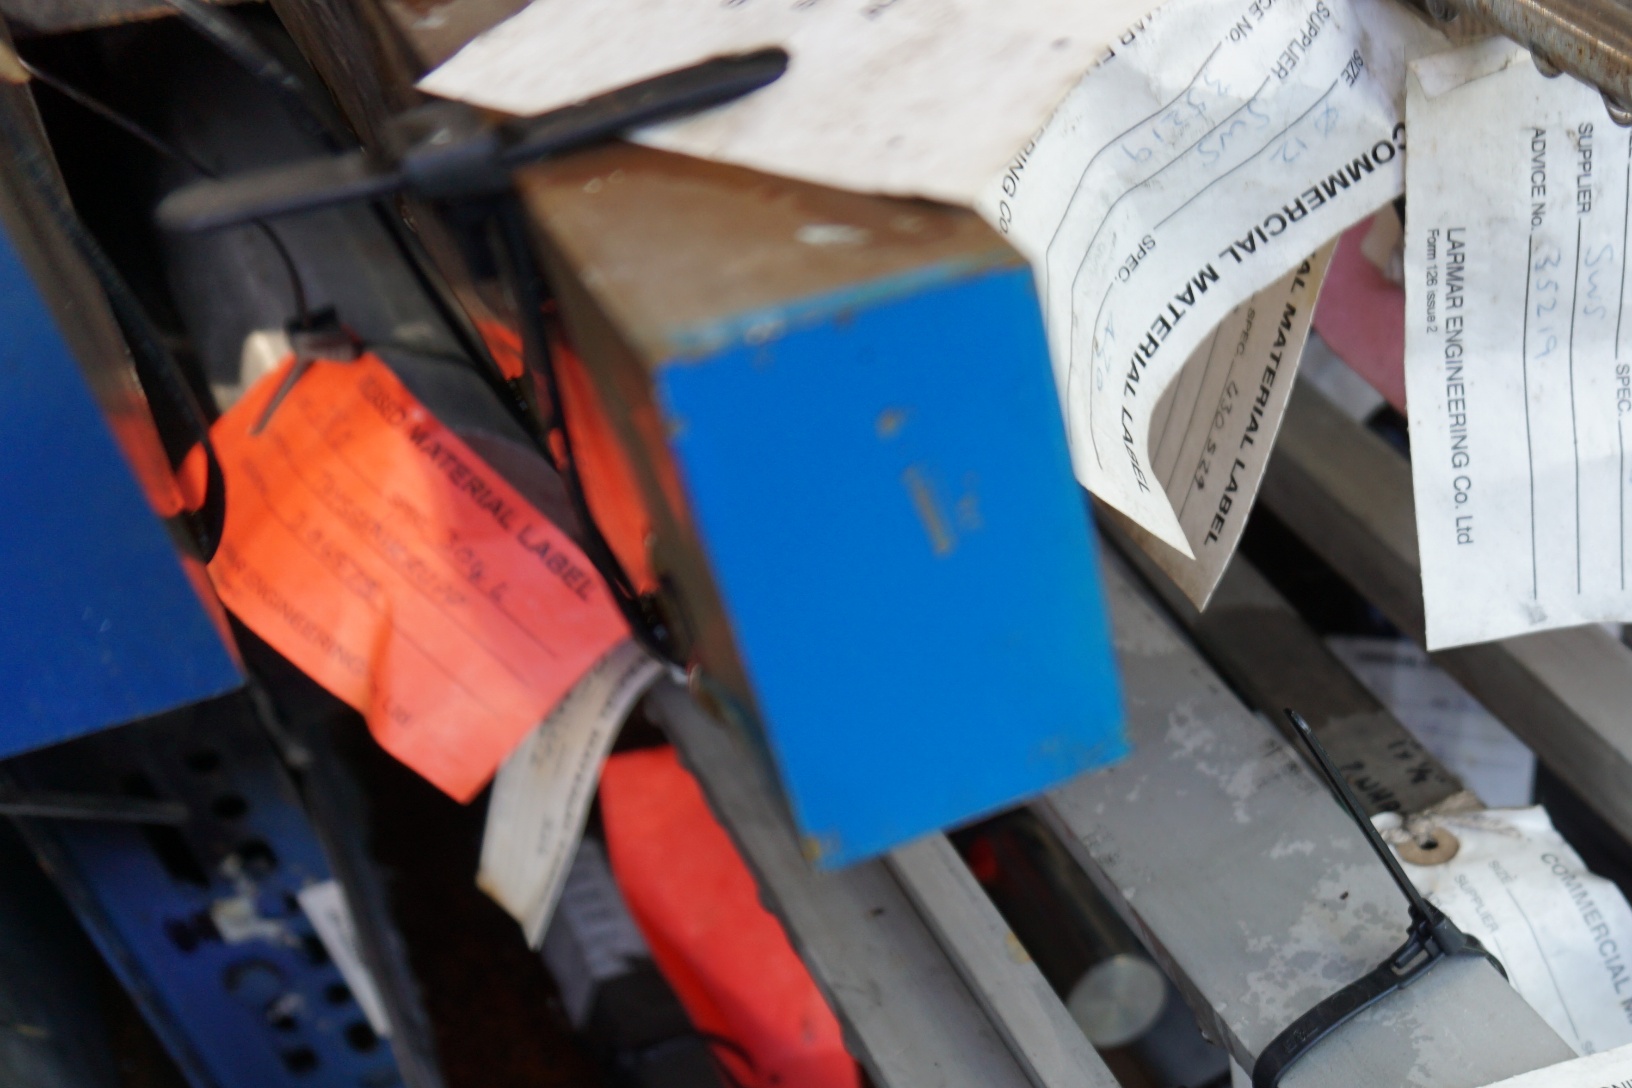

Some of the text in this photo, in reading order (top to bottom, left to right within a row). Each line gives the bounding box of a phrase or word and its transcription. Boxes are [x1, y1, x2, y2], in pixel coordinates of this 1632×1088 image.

[1271, 1, 1330, 80] SUPPLIER
[1341, 48, 1364, 88] SIZE
[1530, 126, 1547, 232] ADVICE No.
[1575, 123, 1594, 214] SUPPLIER
[1111, 234, 1157, 283] SPEC.
[1426, 228, 1440, 261] Form
[1426, 263, 1439, 287] 126
[1124, 263, 1220, 396] MATERIAL
[1426, 289, 1436, 324] issue
[1203, 302, 1297, 546] MATERIAL LABEL
[1444, 227, 1474, 545] LARMAR ENGINEERING Co. Ltd
[1615, 363, 1632, 416] SPEC.
[1121, 406, 1150, 492] LABEL
[408, 422, 514, 529] MATERIAL
[514, 527, 594, 596] LABEL
[1453, 873, 1498, 933] SUPPLIER
[1489, 860, 1512, 886] SIZE
[1540, 852, 1632, 996] COMMERCIAL
